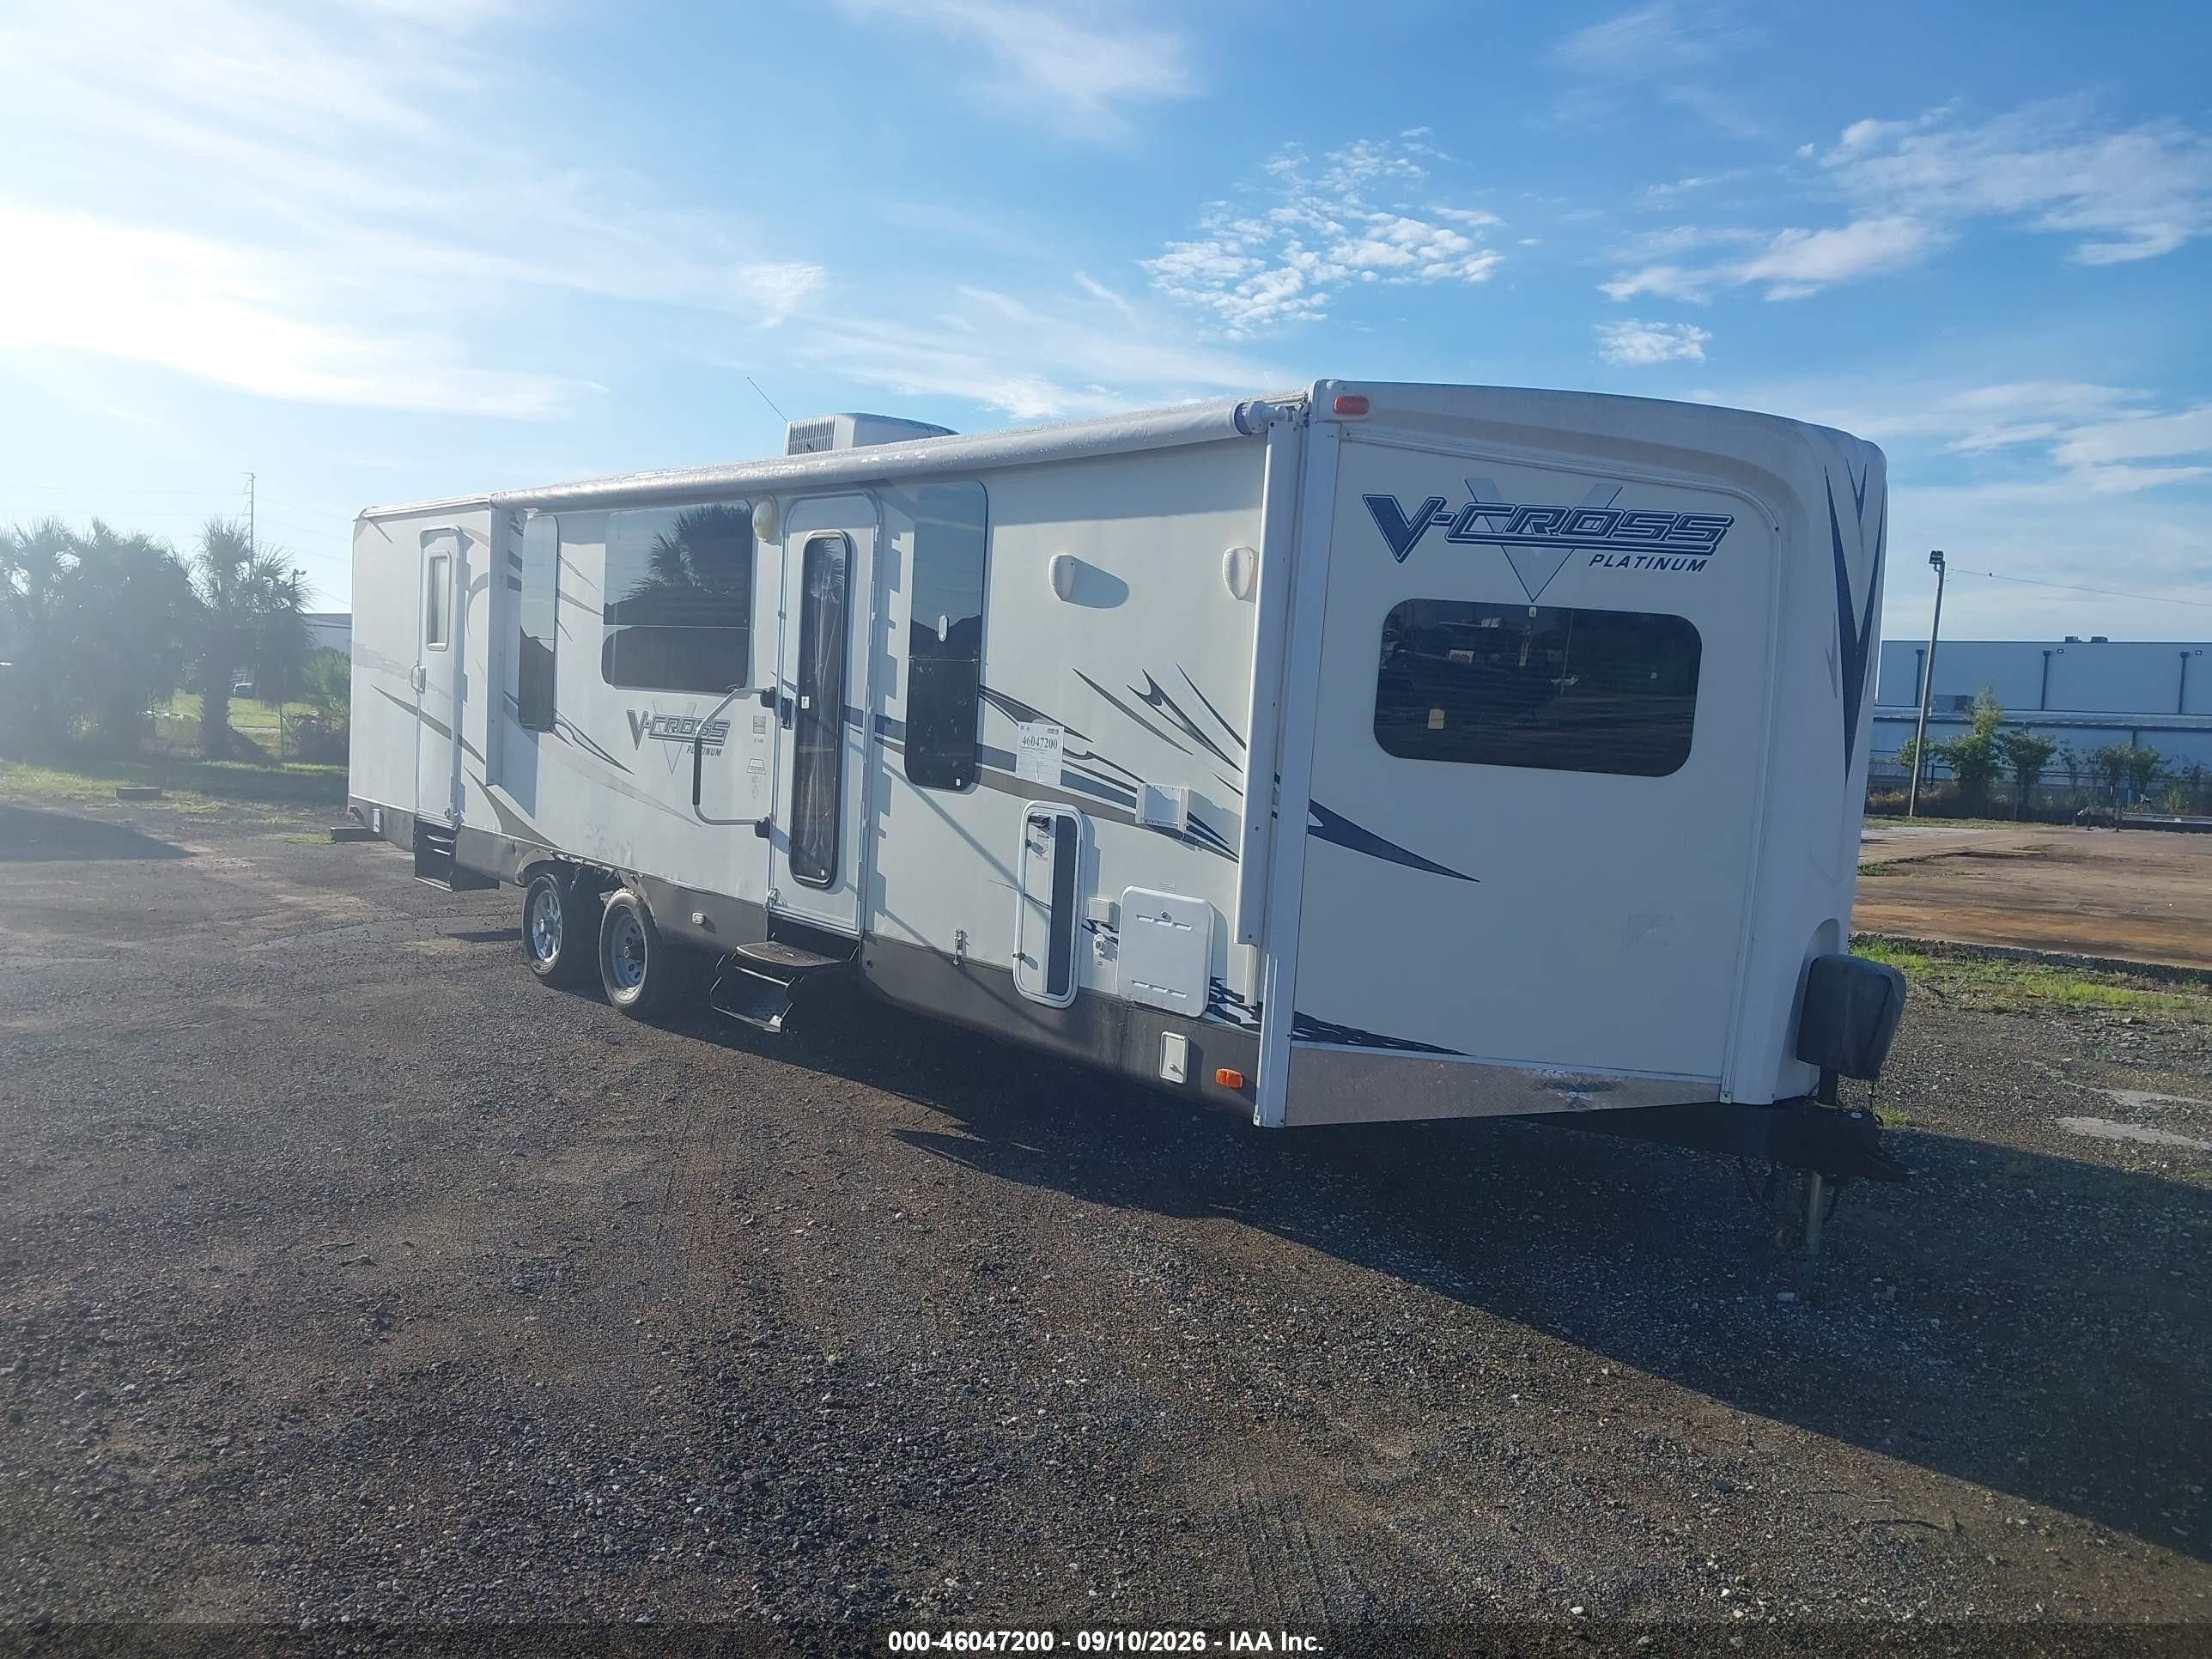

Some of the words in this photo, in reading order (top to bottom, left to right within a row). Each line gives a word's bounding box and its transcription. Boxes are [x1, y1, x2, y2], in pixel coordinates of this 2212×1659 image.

[1362, 494, 1735, 563] V-CROSS
[1589, 554, 1708, 573] PLATINUM
[686, 744, 722, 757] PLINUM
[1022, 735, 1058, 750] 46047200
